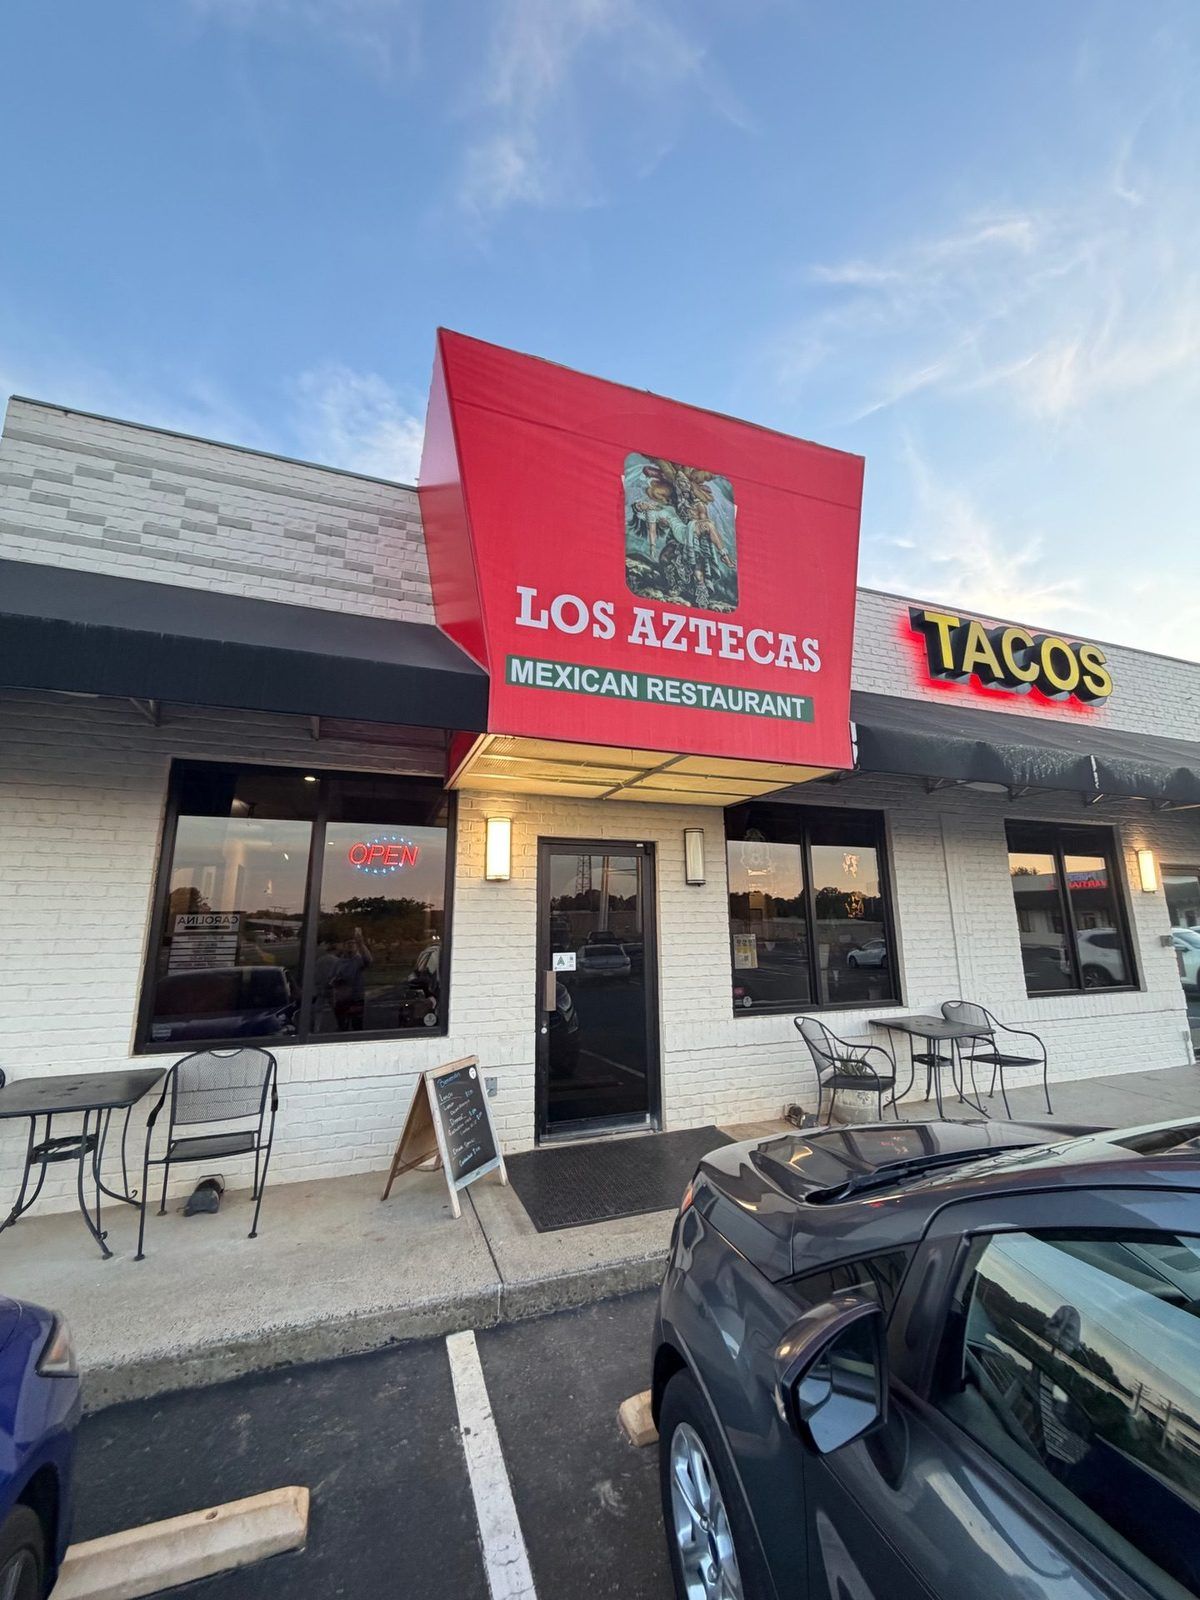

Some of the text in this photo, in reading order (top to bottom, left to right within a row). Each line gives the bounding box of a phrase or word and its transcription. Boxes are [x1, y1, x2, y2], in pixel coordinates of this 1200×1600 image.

[515, 585, 822, 673] LOS AZTECAS
[922, 610, 1114, 698] TACOS
[510, 657, 805, 719] MEXICAN RESTAURANT
[348, 842, 419, 867] OPEN
